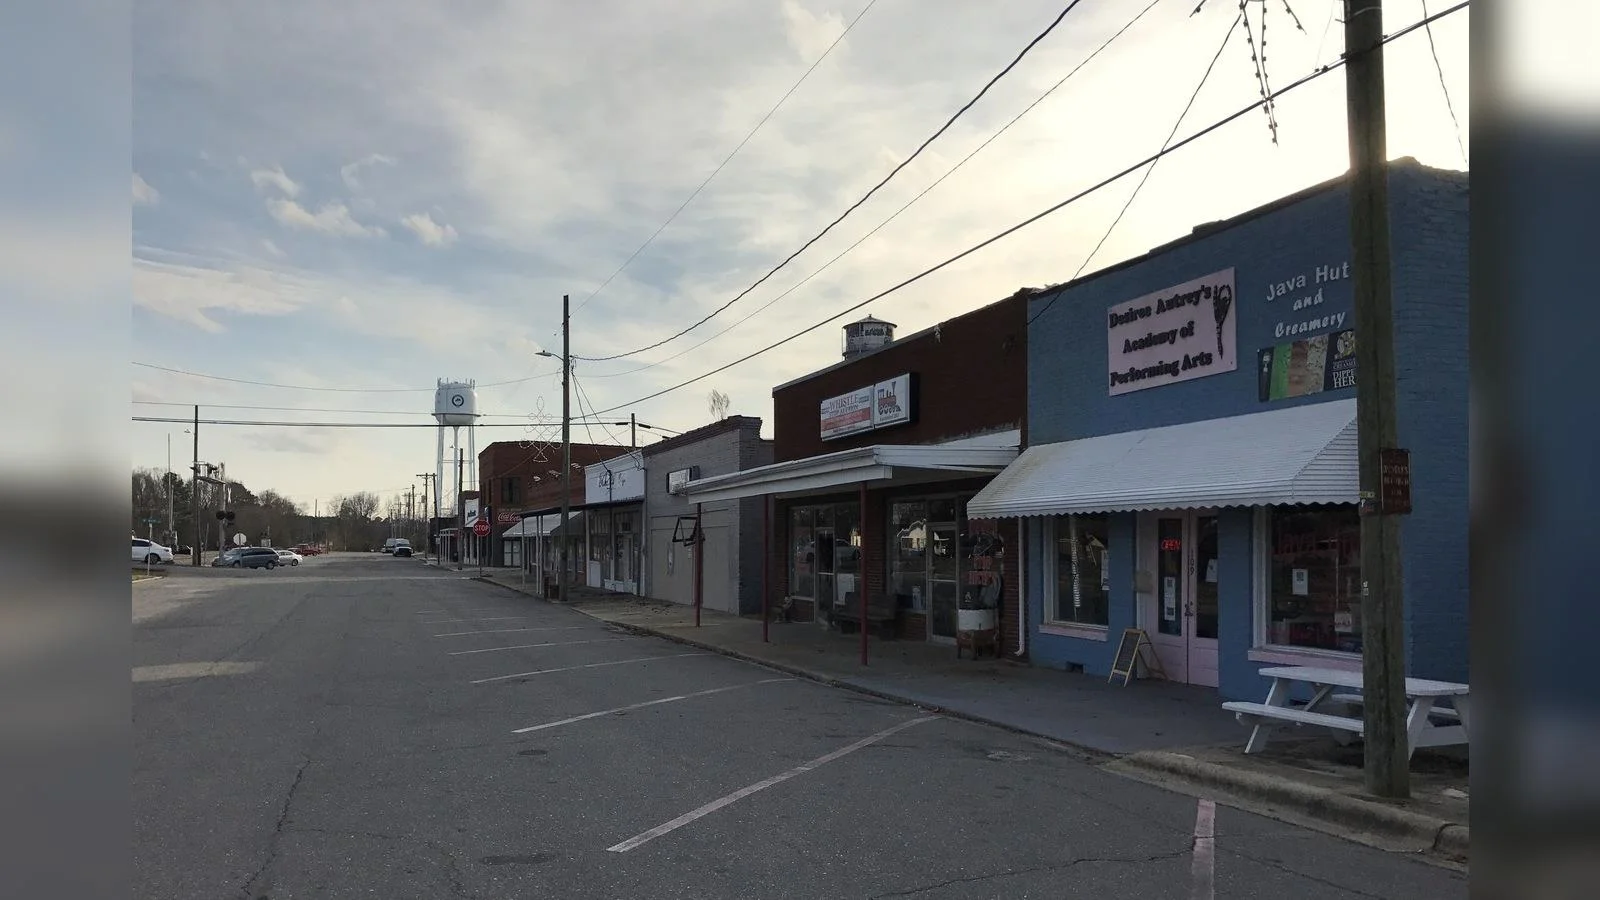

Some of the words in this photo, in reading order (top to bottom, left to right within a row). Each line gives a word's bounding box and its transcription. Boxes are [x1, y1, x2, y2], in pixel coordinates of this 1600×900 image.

[1266, 274, 1306, 302] Java
[1315, 262, 1350, 284] Hut
[1110, 306, 1152, 329] Desiree
[1156, 285, 1211, 315] Autrey's
[1293, 288, 1324, 311] and
[1275, 312, 1346, 338] Creamery
[1123, 329, 1178, 354] Academy
[1180, 321, 1194, 339] of
[1110, 361, 1179, 387] Performing
[1181, 352, 1212, 371] Arts
[1332, 369, 1355, 382] DIPPE
[1334, 376, 1356, 388] HER
[830, 394, 857, 412] WHISTLE
[1161, 538, 1181, 551] OPEN
